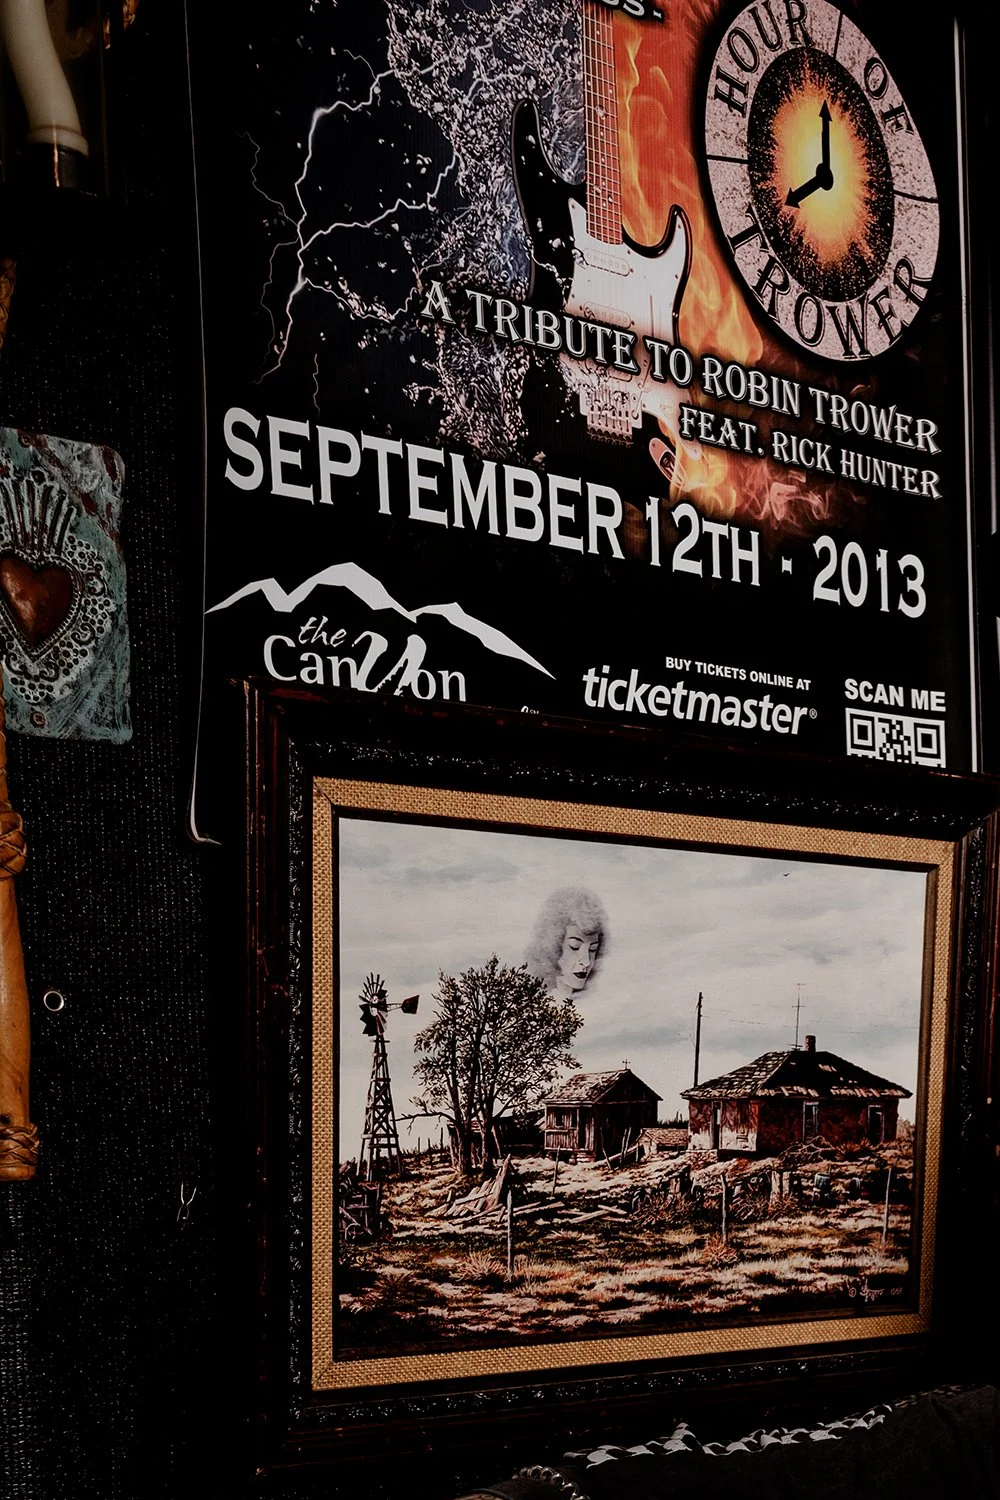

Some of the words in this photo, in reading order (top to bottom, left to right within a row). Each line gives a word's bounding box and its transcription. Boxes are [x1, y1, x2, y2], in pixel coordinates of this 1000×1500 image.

[713, 0, 812, 115] HOUR
[865, 54, 918, 138] OF
[727, 222, 936, 361] TROWER
[420, 280, 450, 320] A
[467, 294, 639, 373] TRIBUTE
[644, 344, 692, 387] TO
[702, 361, 801, 418] ROBIN
[809, 394, 942, 455] TROWER
[678, 403, 767, 461] FEAT.
[772, 431, 834, 474] RICK
[839, 450, 943, 501] HUNTER
[223, 406, 626, 560] SEPTEMBER
[644, 496, 763, 587] 12TH
[813, 534, 927, 619] 2013
[299, 615, 348, 648] the
[665, 656, 691, 672] BUY
[695, 661, 746, 681] TICKETS
[749, 671, 793, 688] ONLINE
[795, 679, 811, 691] AT
[844, 678, 904, 706] SCAN
[911, 690, 946, 712] ME
